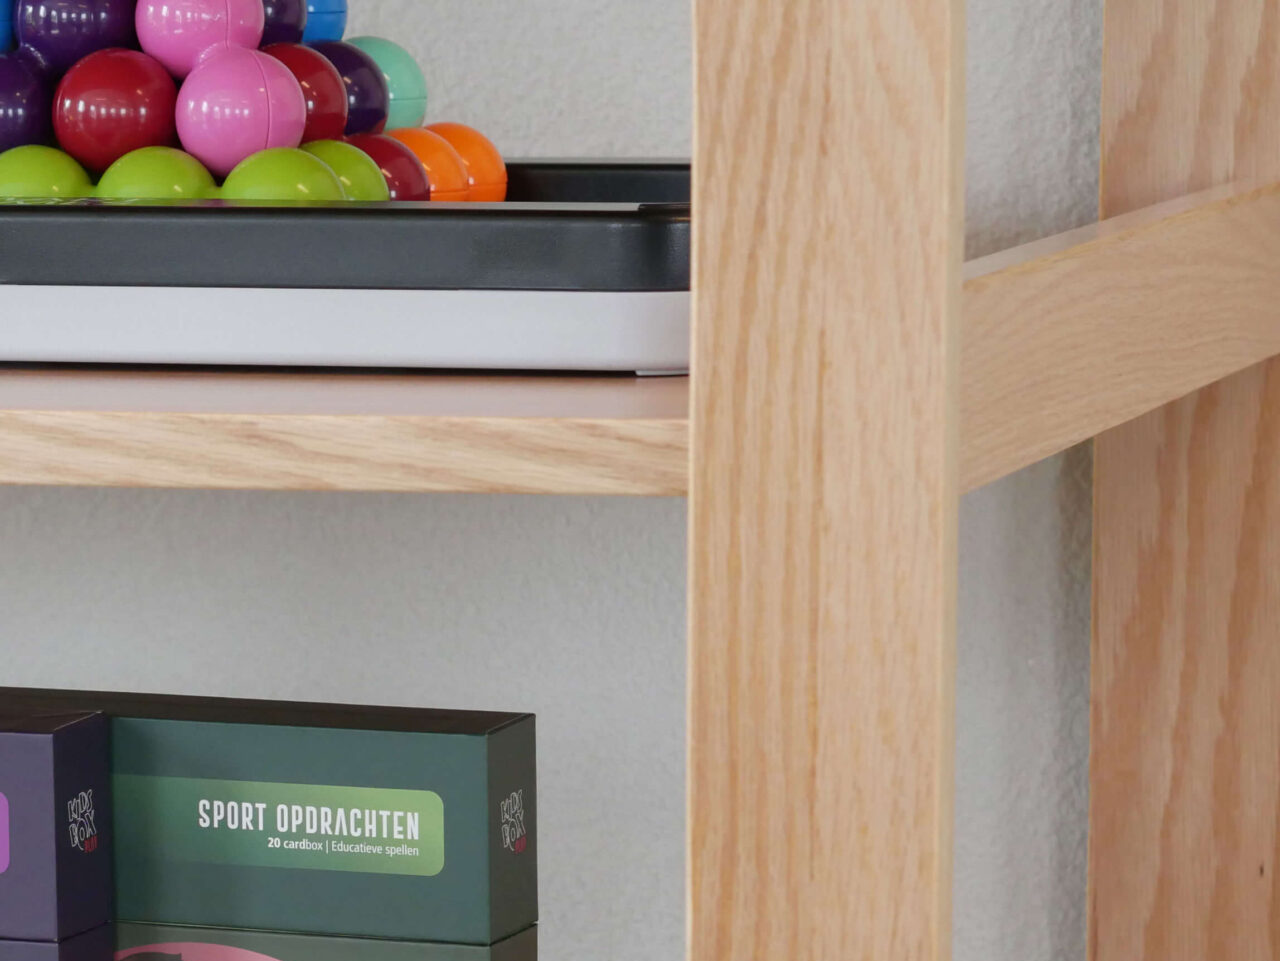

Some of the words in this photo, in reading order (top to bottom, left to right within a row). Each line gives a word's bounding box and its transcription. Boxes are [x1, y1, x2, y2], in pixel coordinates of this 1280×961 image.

[67, 789, 93, 822] KIDS
[198, 799, 267, 831] SPORT
[276, 803, 419, 841] OPDRACHTEN
[68, 809, 96, 851] BOX
[267, 837, 281, 849] 20
[283, 838, 323, 851] cardbox
[331, 840, 383, 855] Educatieve
[385, 844, 419, 857] spellen
